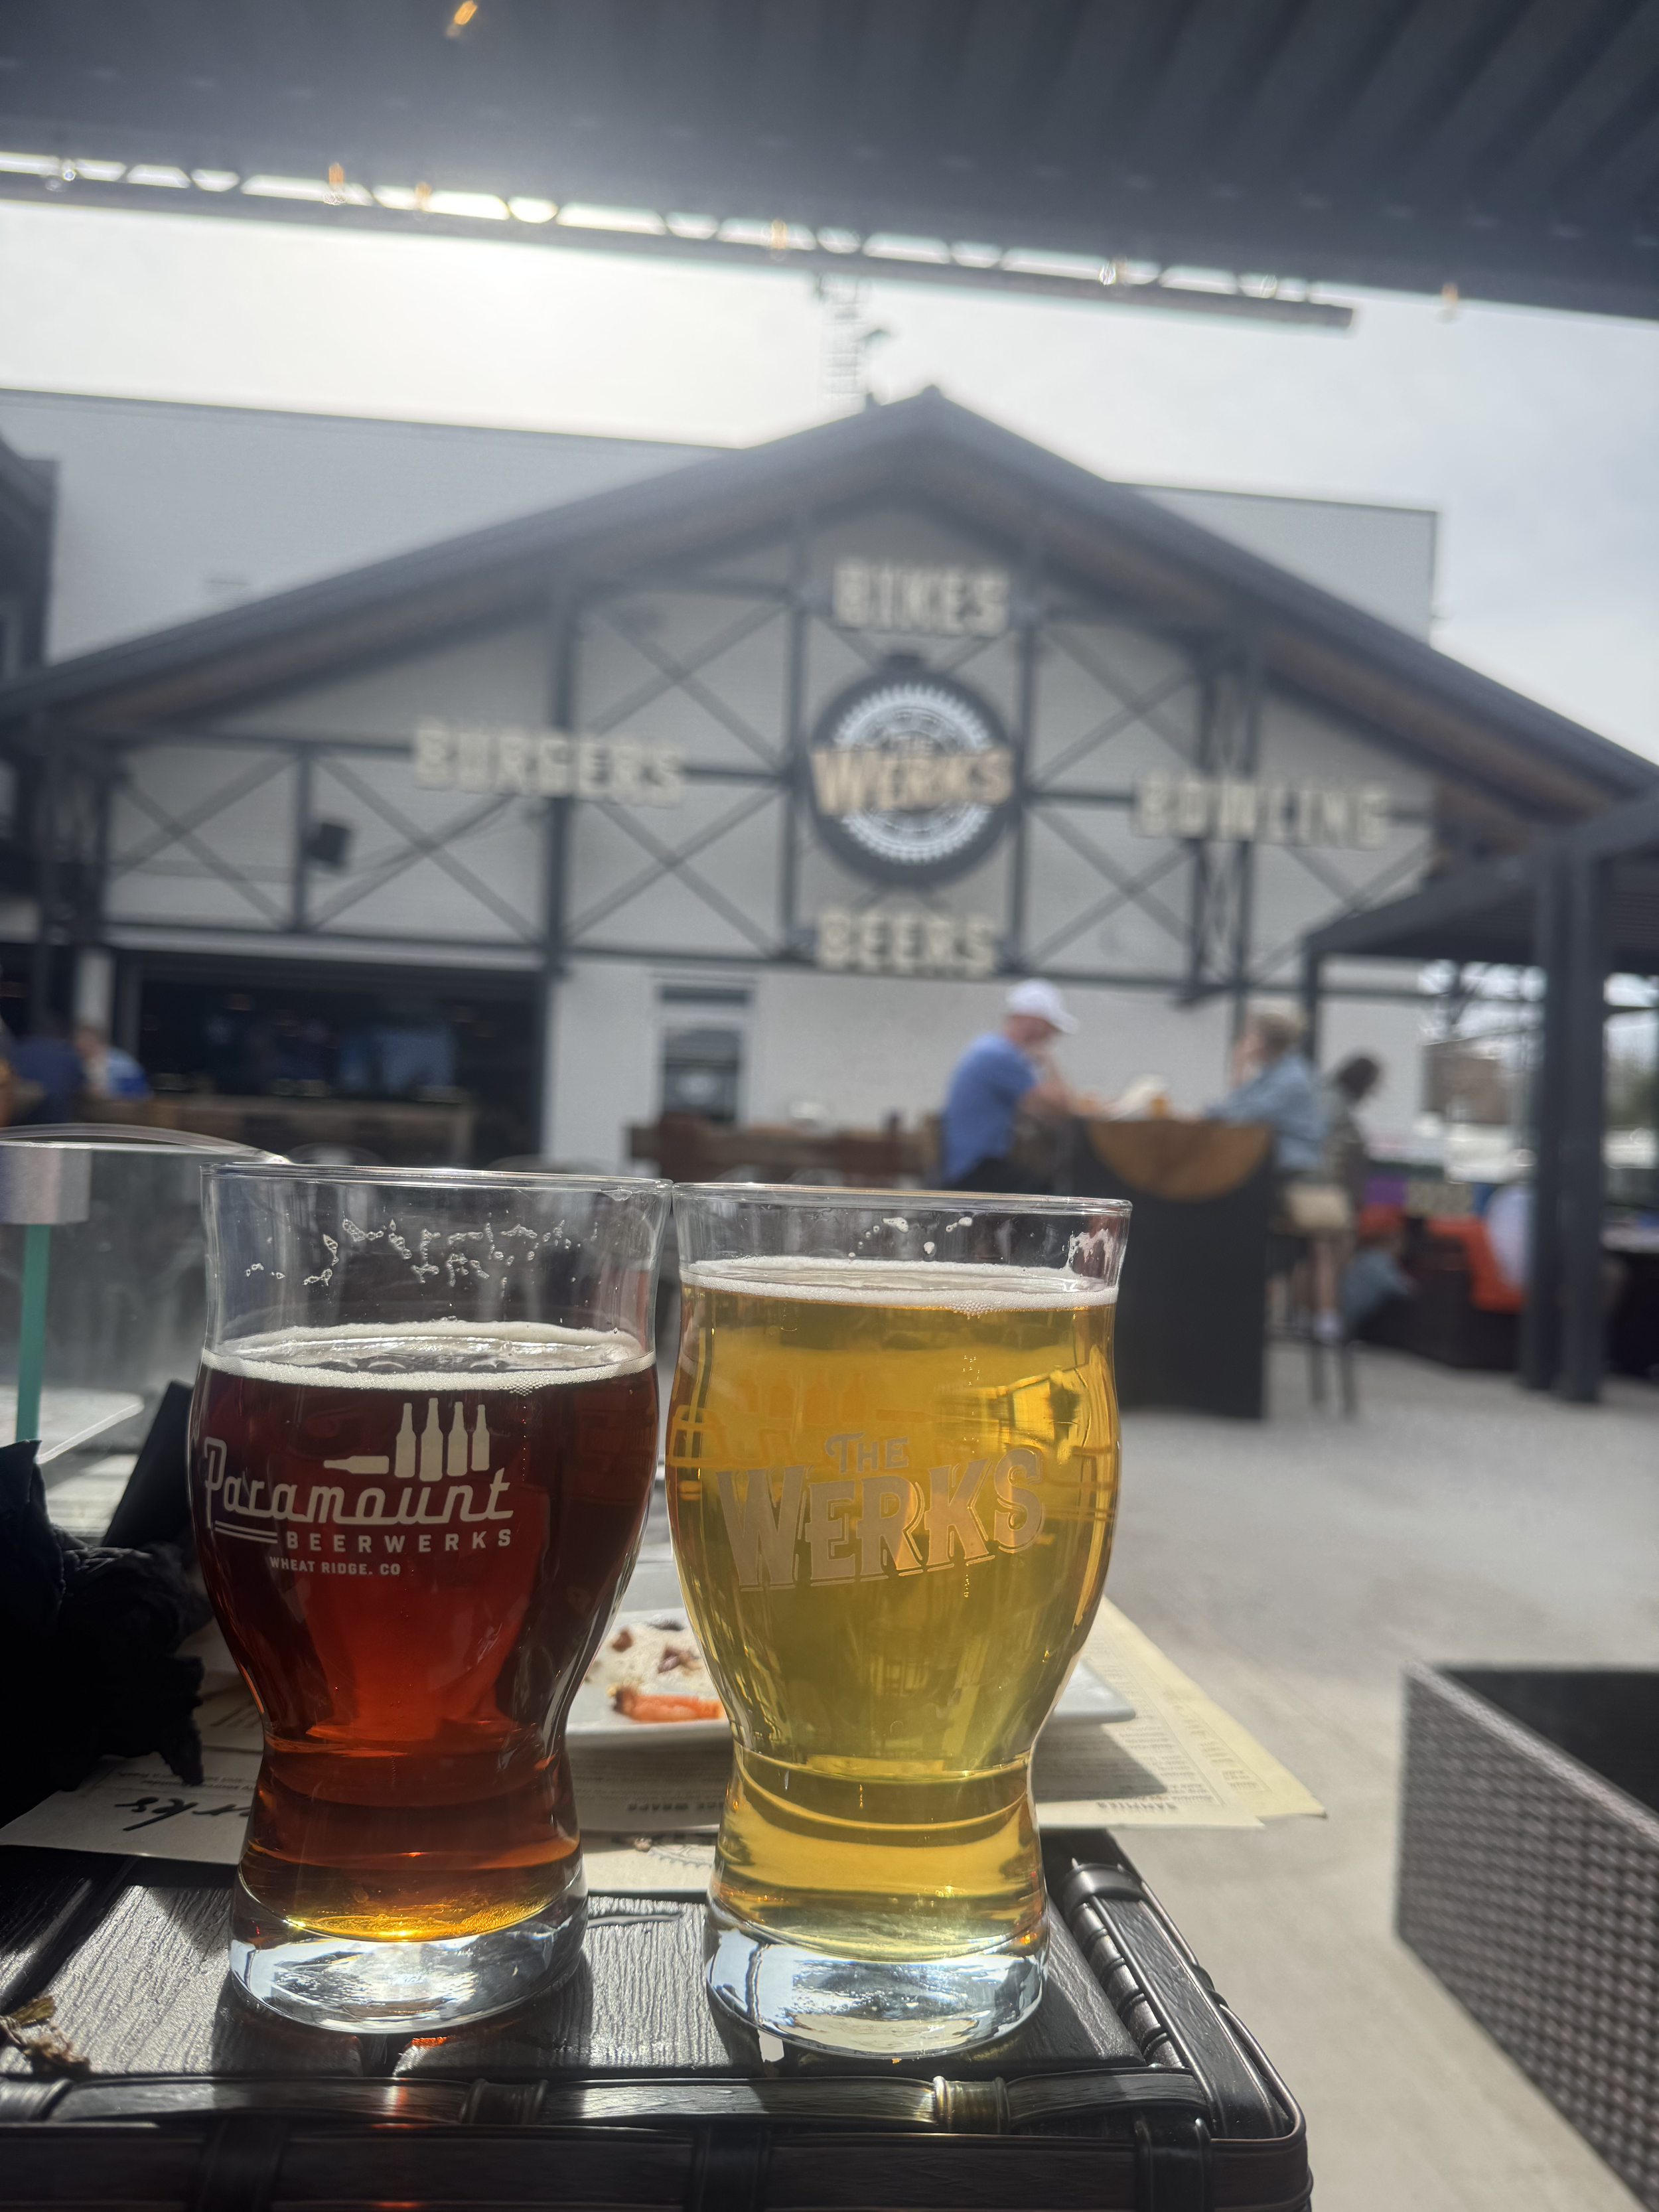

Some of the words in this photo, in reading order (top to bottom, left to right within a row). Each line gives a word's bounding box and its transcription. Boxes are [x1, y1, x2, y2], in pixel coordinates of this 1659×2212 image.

[833, 563, 1010, 635] BIKES
[415, 721, 685, 808] BURGERS
[811, 746, 1013, 816] WERKS
[1133, 771, 1390, 851] BOWLING
[816, 907, 999, 978] BEERS
[204, 1436, 514, 1528] Paramount
[715, 1446, 1046, 1591] WERKS
[269, 1556, 315, 1573] WHEAT
[380, 1563, 401, 1576] CO
